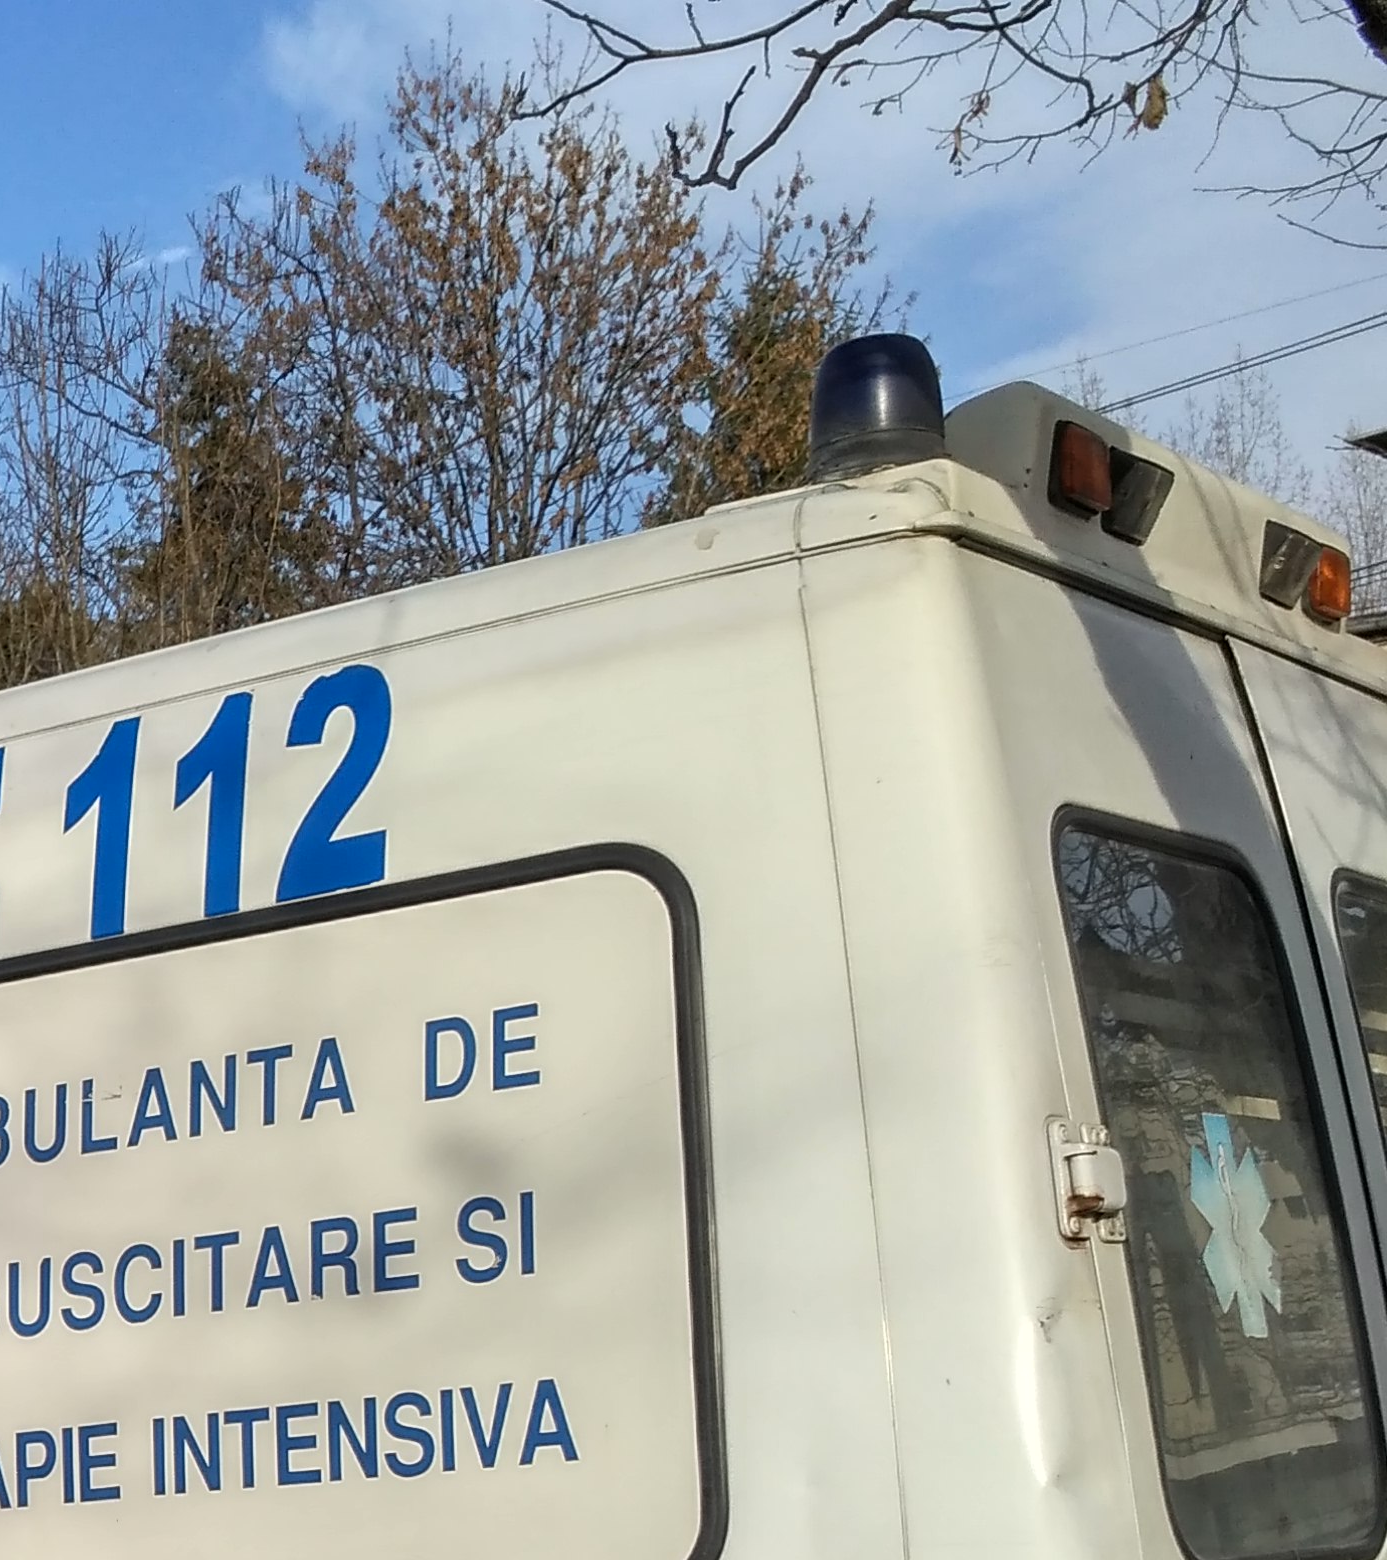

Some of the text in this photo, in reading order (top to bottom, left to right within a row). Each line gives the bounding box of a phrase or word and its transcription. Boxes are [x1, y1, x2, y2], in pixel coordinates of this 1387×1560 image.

[63, 664, 393, 940] 112
[425, 1003, 542, 1102] DE
[456, 1191, 536, 1285] SI
[153, 1379, 579, 1497] INTENSIVA
